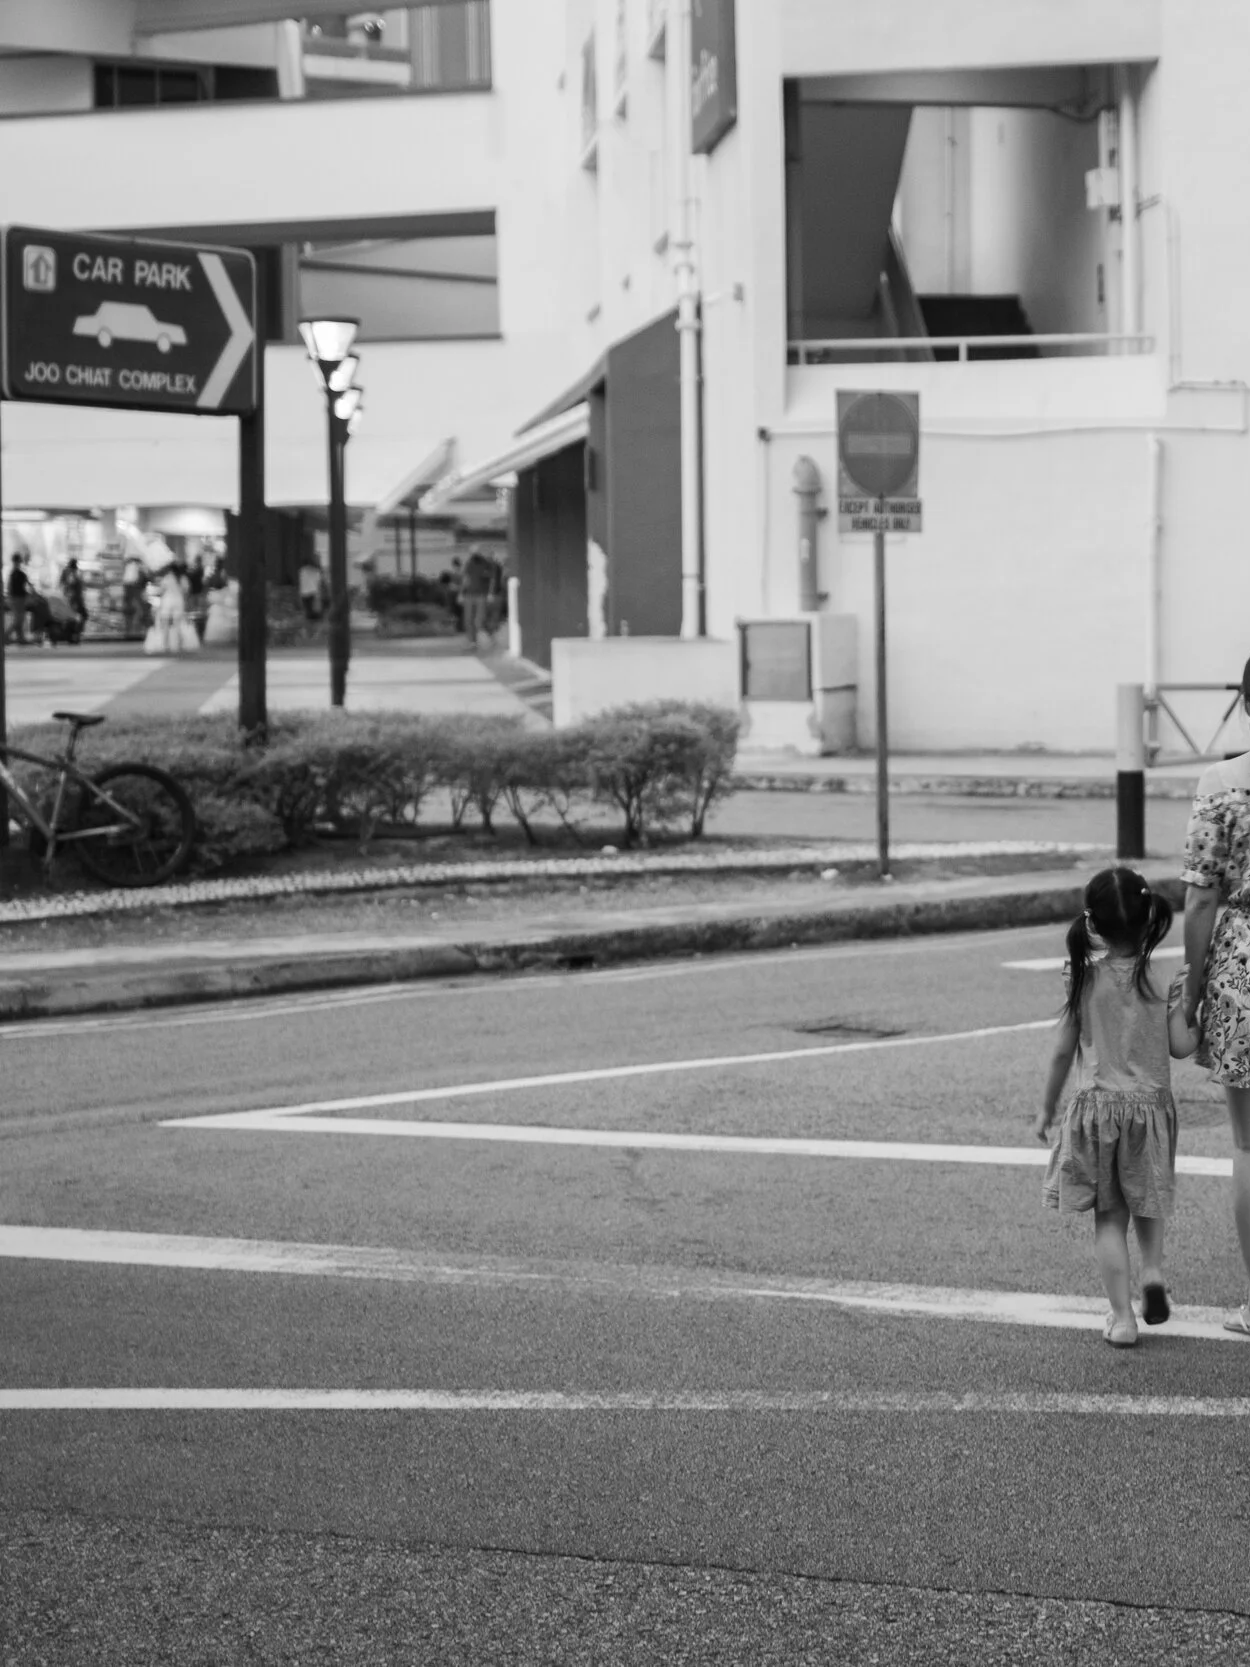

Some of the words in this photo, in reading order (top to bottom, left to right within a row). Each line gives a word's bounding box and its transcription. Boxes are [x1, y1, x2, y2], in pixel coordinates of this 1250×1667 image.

[73, 253, 123, 283] CAR
[134, 260, 192, 290] PARK
[24, 362, 60, 383] JOO
[66, 365, 112, 387] CHIAT
[119, 369, 196, 394] COMPLEX
